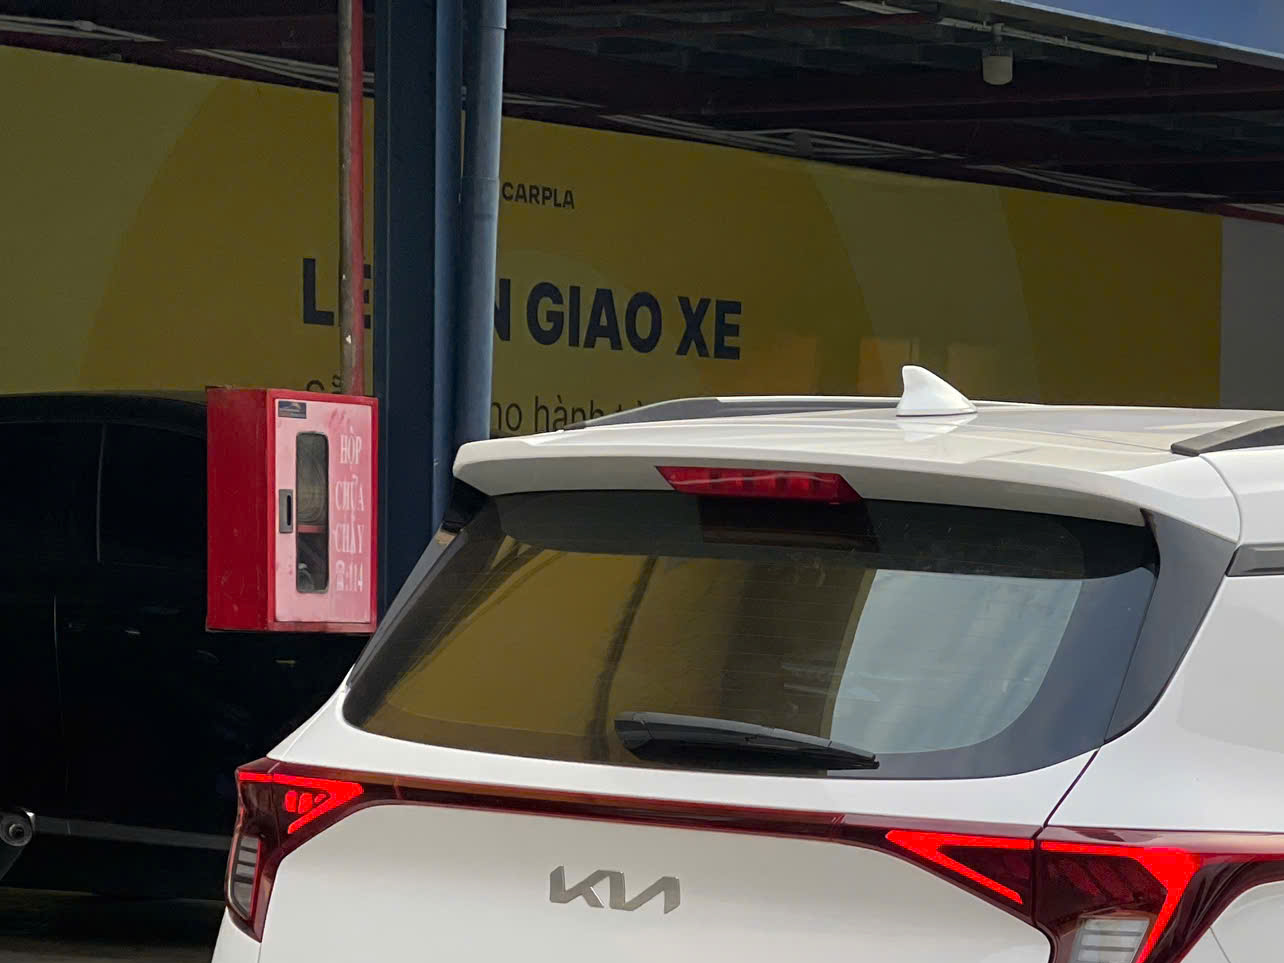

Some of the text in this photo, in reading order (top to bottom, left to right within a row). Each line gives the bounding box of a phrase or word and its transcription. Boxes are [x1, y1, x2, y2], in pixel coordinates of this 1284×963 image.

[501, 181, 575, 210] CARPLA
[527, 281, 662, 353] GIAO
[676, 295, 742, 360] XE
[549, 865, 681, 914] KIA
